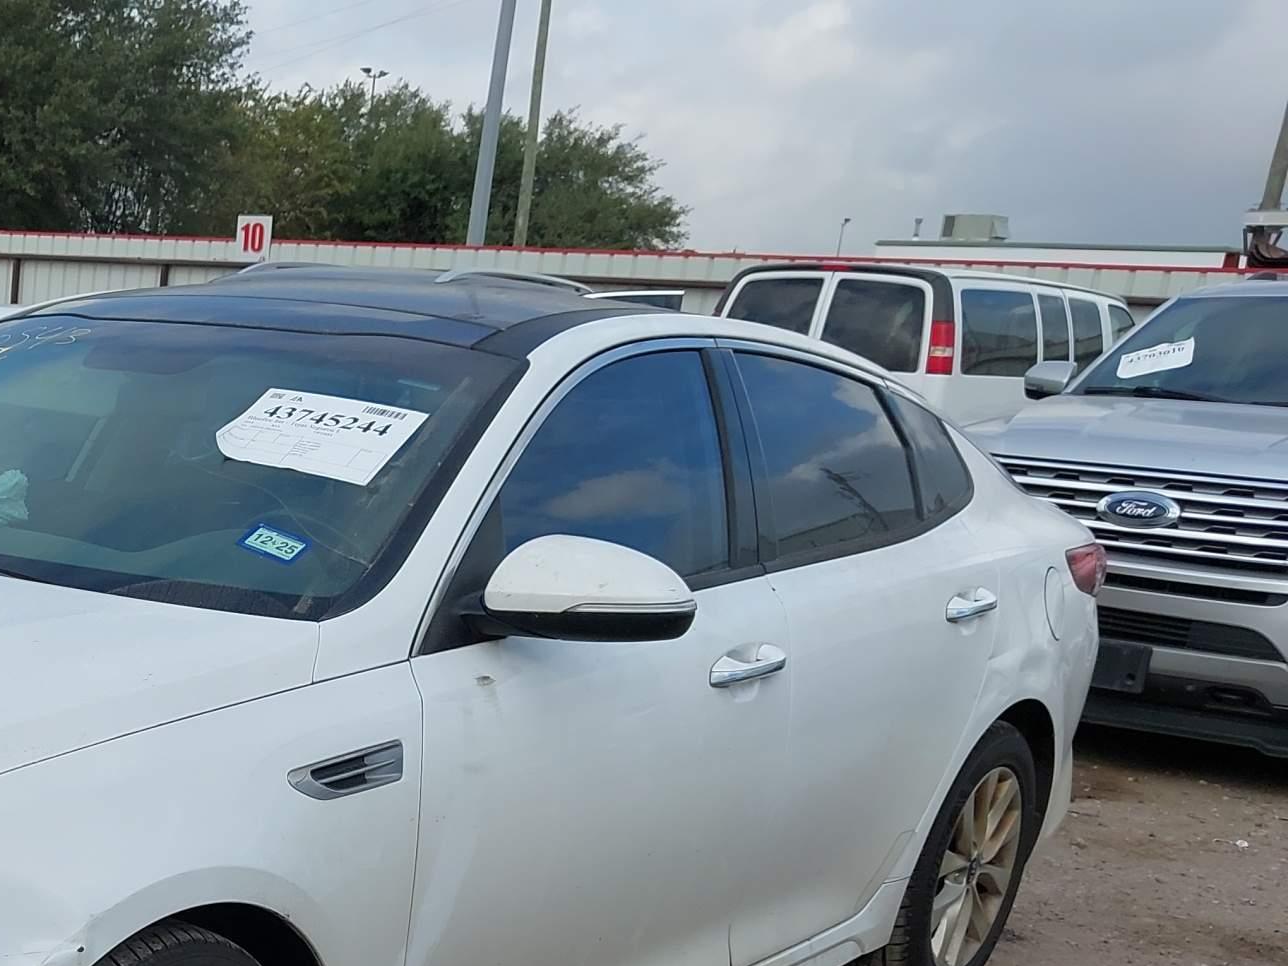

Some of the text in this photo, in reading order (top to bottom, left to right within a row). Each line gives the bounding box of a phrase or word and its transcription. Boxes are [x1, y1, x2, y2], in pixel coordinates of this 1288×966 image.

[240, 222, 265, 252] 10
[263, 405, 393, 437] 43745244
[1115, 500, 1158, 518] Ford
[253, 532, 299, 555] 12 25
